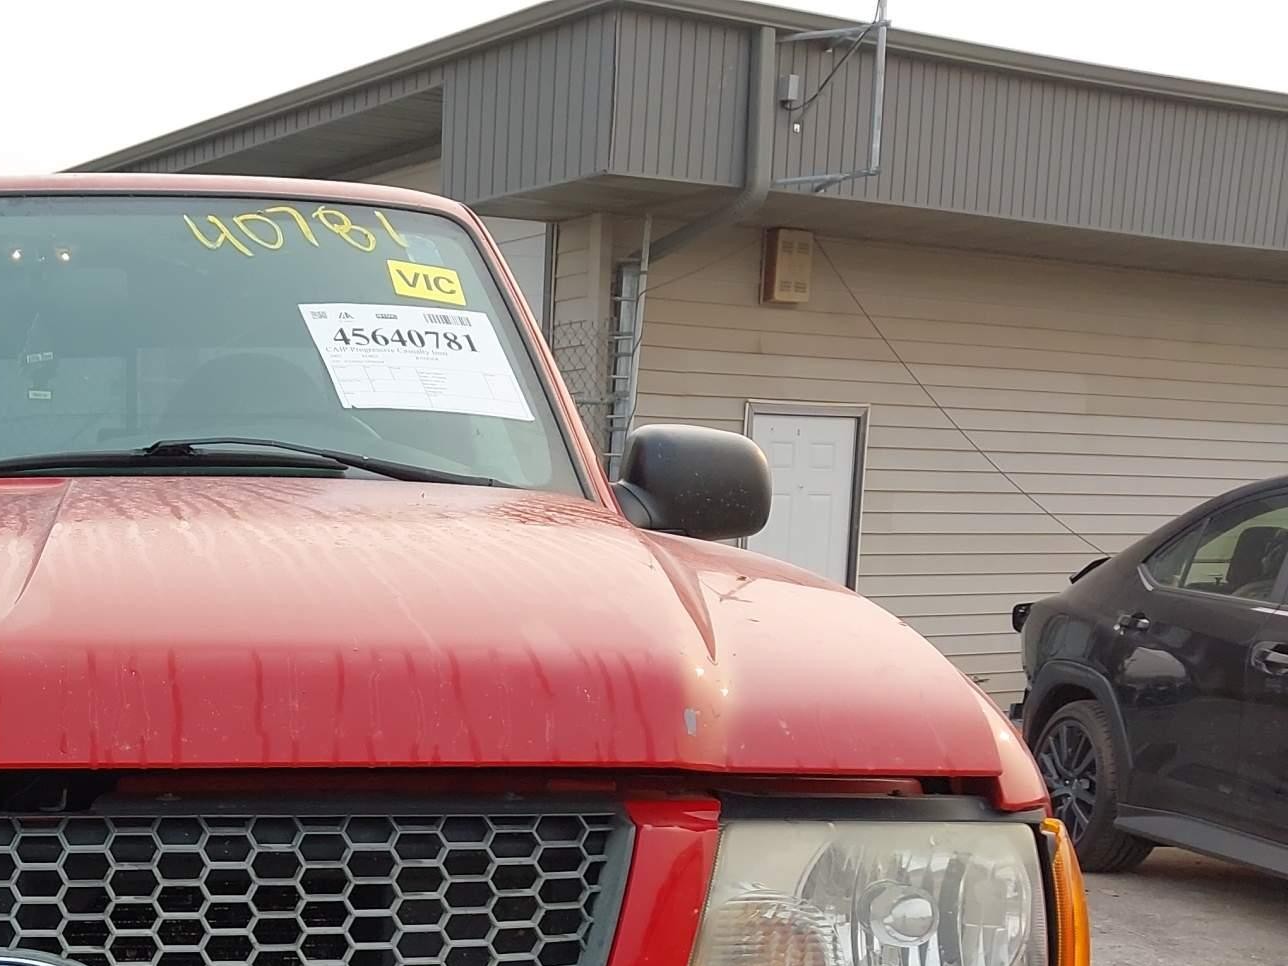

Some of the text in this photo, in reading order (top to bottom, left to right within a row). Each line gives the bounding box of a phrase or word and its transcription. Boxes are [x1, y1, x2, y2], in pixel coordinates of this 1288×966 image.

[183, 204, 410, 257] 40781
[395, 268, 458, 295] VIC
[333, 327, 479, 352] 45640781
